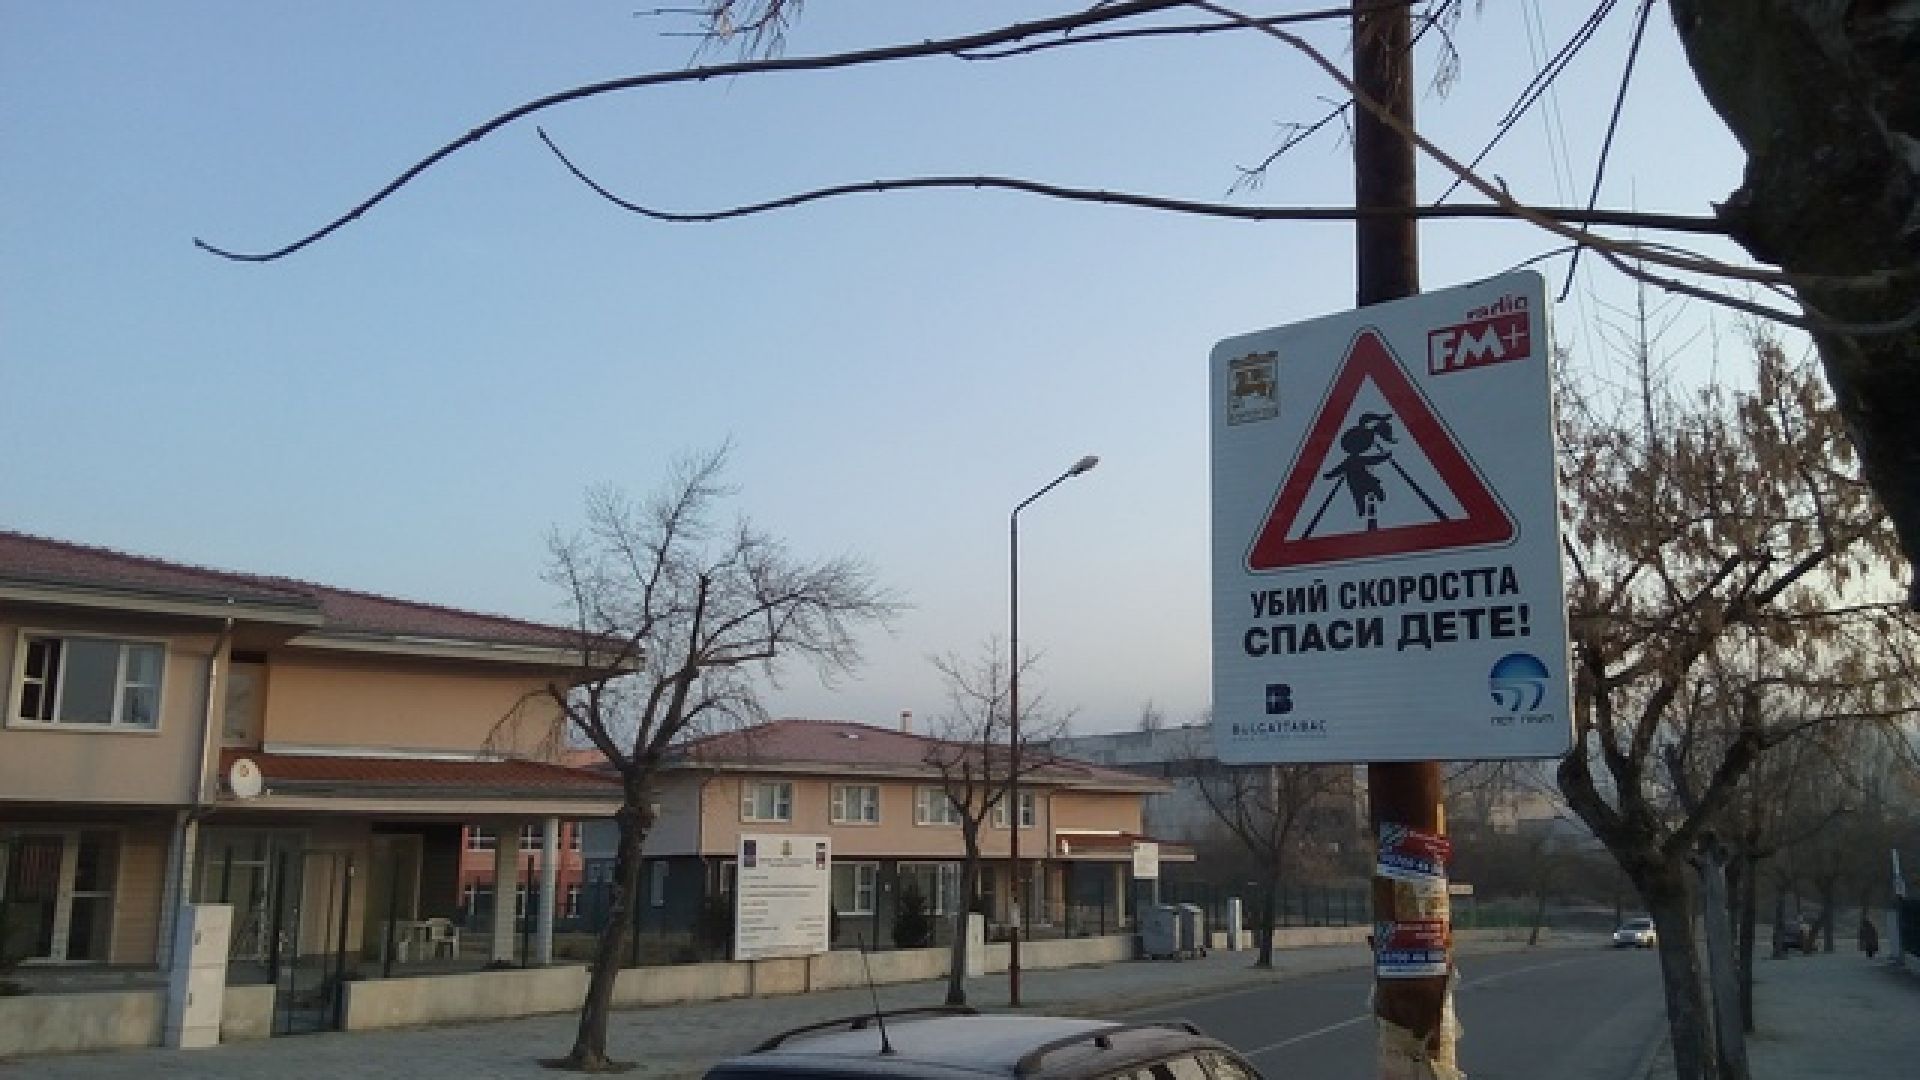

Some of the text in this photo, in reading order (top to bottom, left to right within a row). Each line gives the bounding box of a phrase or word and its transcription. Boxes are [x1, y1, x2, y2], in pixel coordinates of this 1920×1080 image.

[1466, 294, 1528, 319] radio
[1250, 565, 1519, 618] УБИЙ СКОРОСТТА
[1243, 602, 1531, 657] СПАСИ ДЕТЕ!
